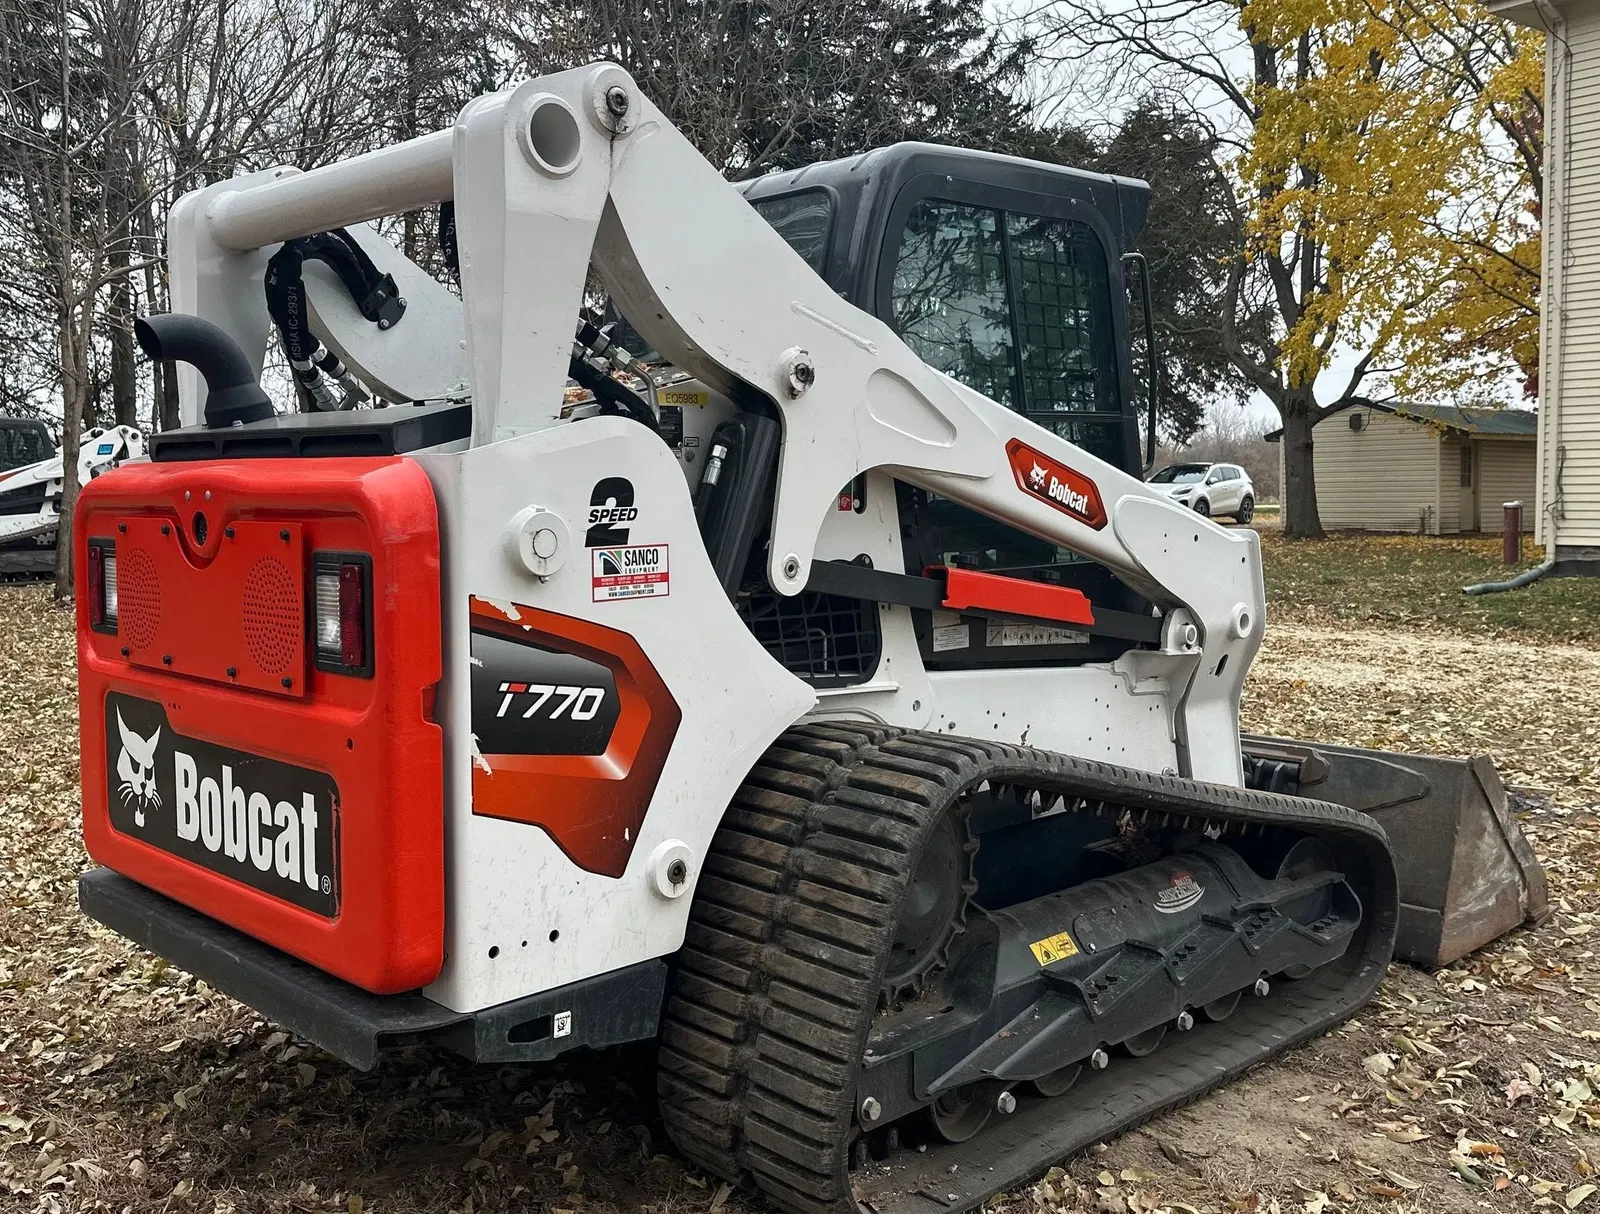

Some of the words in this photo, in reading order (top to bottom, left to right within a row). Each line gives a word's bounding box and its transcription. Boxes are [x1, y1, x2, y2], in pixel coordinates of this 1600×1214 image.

[665, 393, 698, 404] EQ5983
[1048, 476, 1088, 514] Bobcat
[585, 476, 635, 548] 2
[588, 508, 638, 523] SPEED
[624, 548, 659, 567] SANCO
[624, 566, 659, 574] EQUIPMENT
[496, 682, 606, 721] T770
[174, 750, 320, 892] Bobcat
